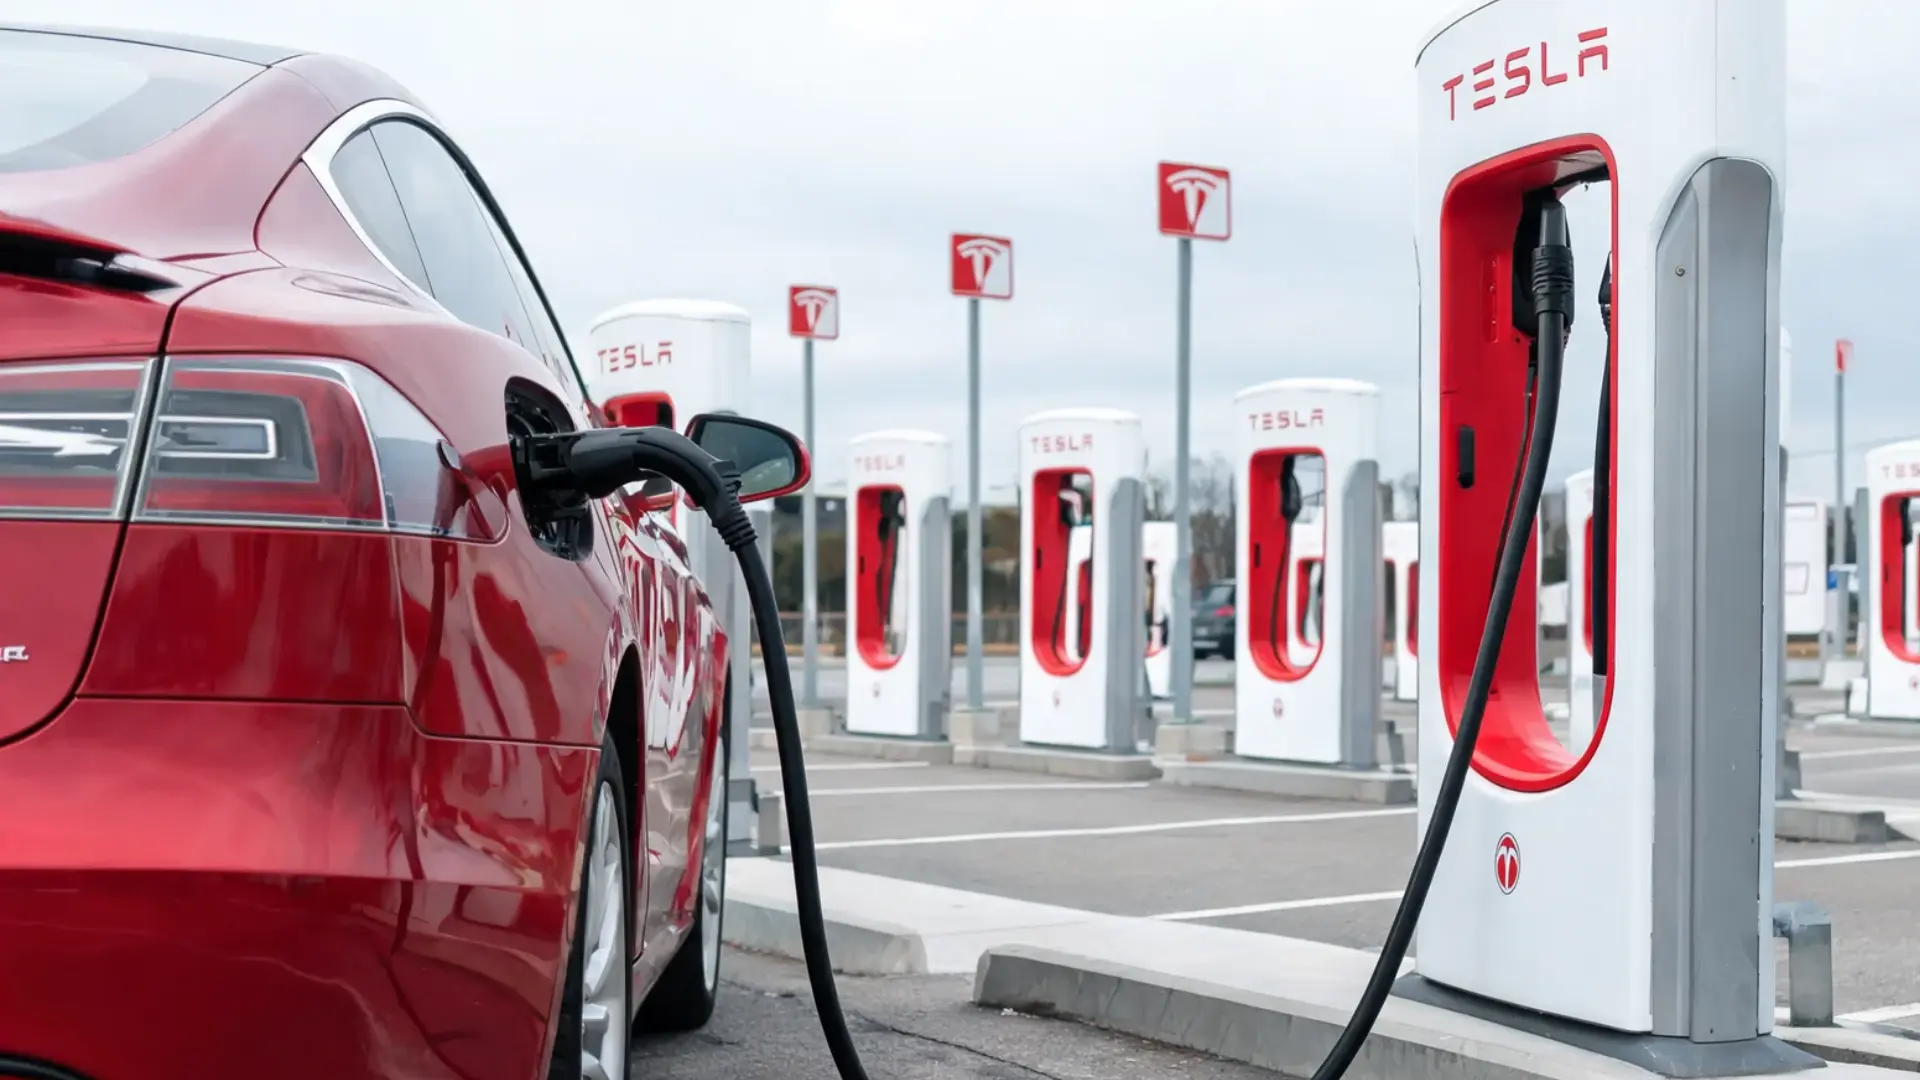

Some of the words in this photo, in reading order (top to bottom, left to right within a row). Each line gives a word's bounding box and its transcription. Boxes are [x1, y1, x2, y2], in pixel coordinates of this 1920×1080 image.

[1443, 27, 1608, 121] TESLA
[597, 341, 672, 374] TESLA
[1249, 408, 1324, 431] TESLA
[1029, 434, 1093, 455] TESLA
